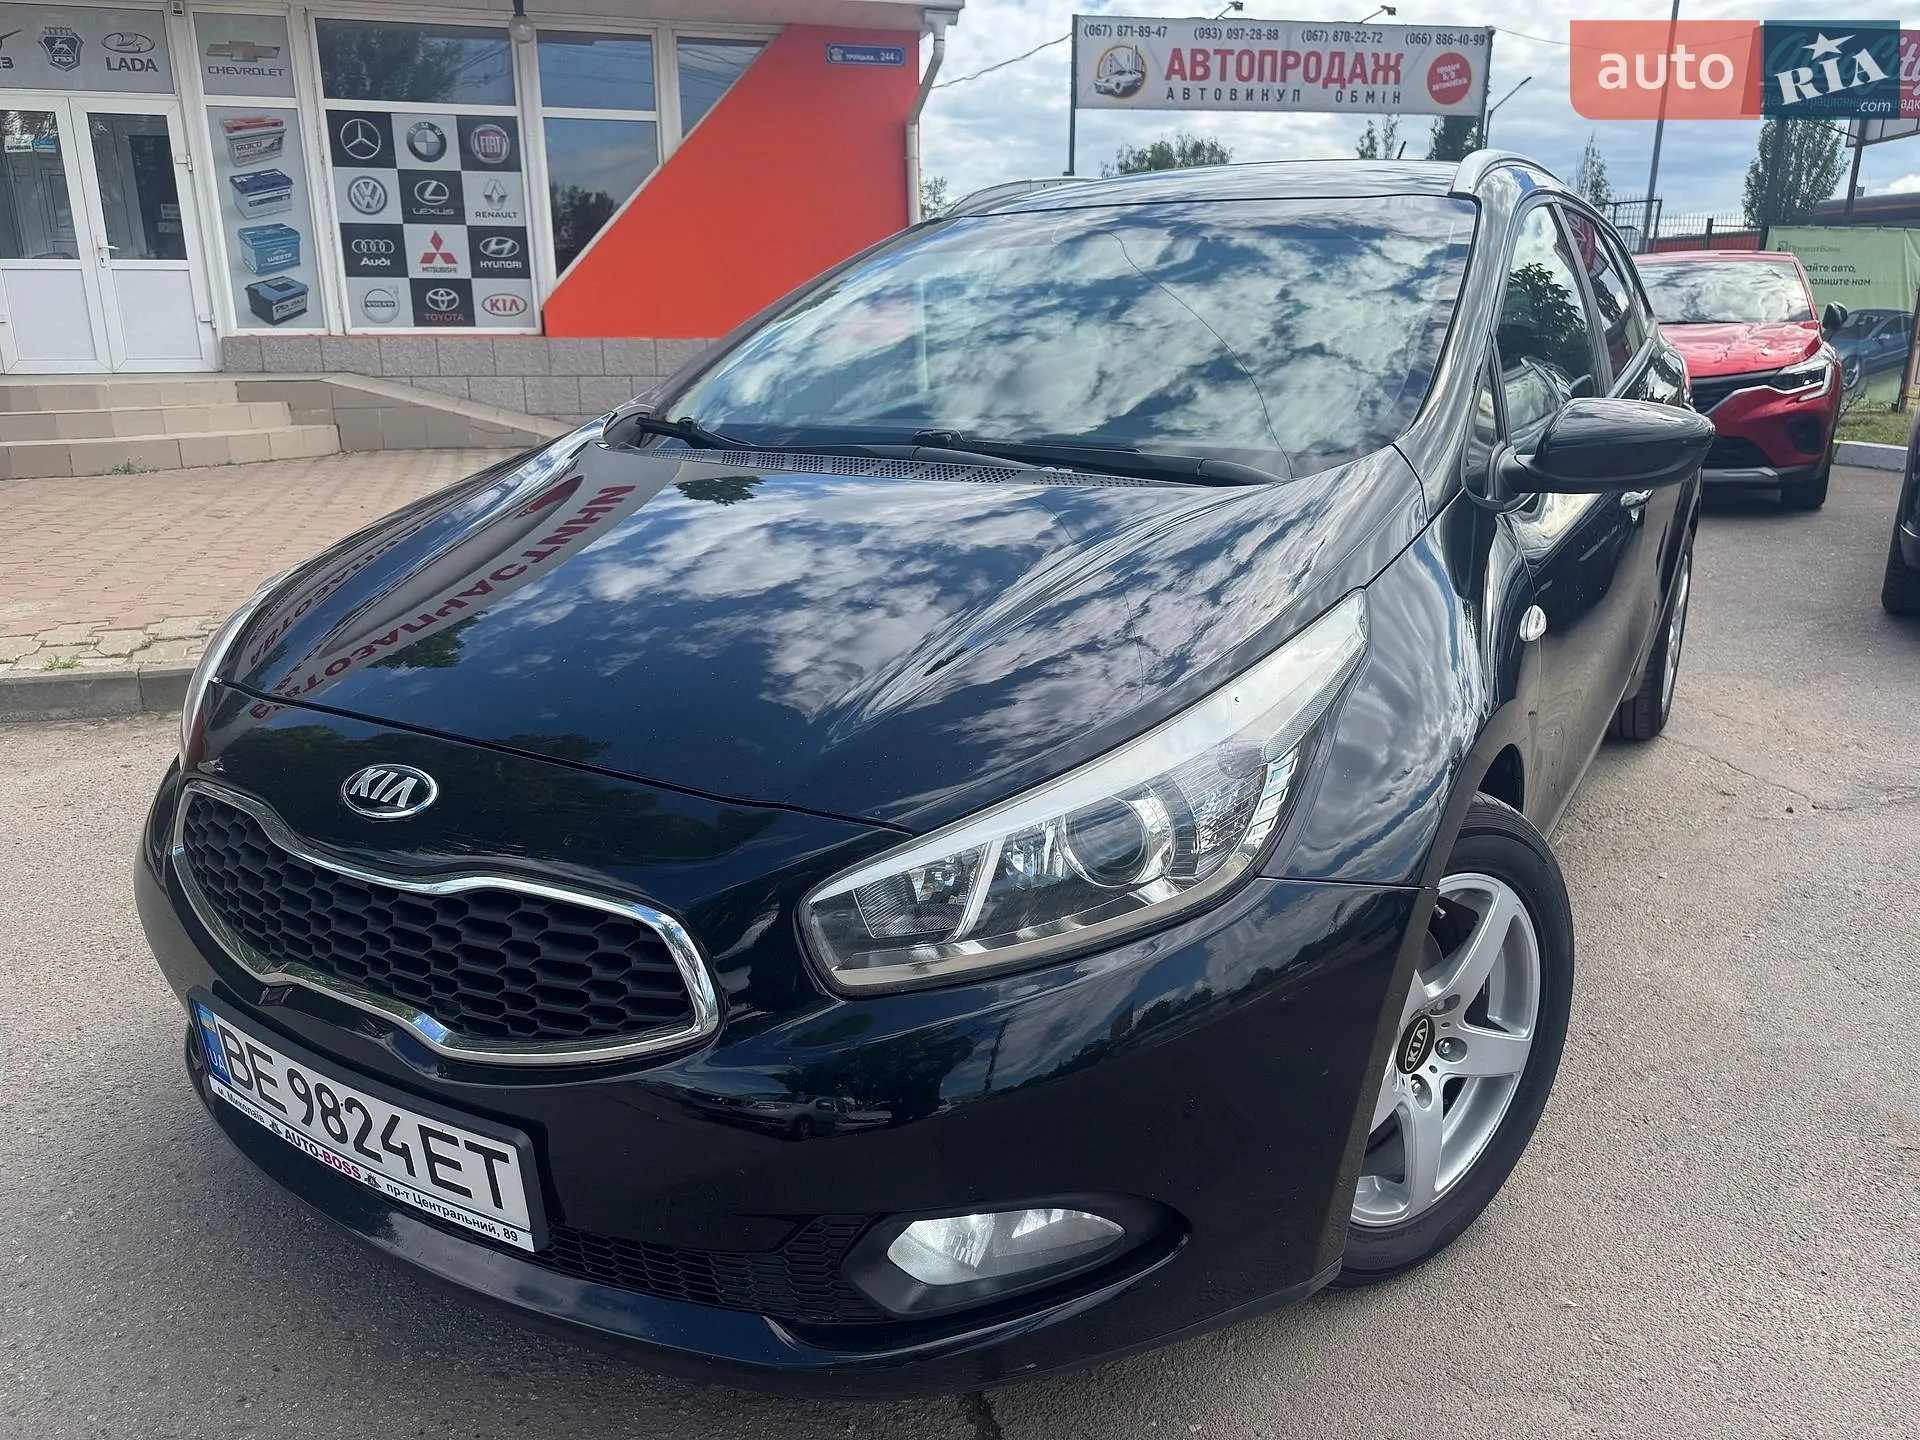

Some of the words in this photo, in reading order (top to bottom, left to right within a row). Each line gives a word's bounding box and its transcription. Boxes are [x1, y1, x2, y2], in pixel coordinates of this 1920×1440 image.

[1083, 24, 1112, 38] (067)
[1117, 24, 1168, 38] 871-89-47
[1194, 26, 1222, 40] (093)
[1227, 27, 1279, 40] 097-28-88
[1301, 30, 1328, 43] (067)
[1332, 30, 1383, 43] 870-22-72
[1405, 32, 1432, 46] (066)
[1435, 33, 1485, 46] 886-40-99
[106, 57, 159, 73] LADA
[208, 65, 285, 78] CHEVROLET
[1164, 48, 1403, 89] АВТОПРОДАЖ
[1166, 87, 1301, 102] АВТОВИКУП
[1335, 90, 1401, 104] ОБМІН
[479, 135, 506, 153] FIAT
[413, 207, 454, 215] LEXUS
[475, 211, 518, 219] RENAULT
[360, 257, 391, 266] Audi
[479, 261, 522, 269] HYUNDAI
[1803, 263, 1829, 272] айте
[1831, 264, 1856, 273] авто,
[489, 299, 520, 312] KIA
[424, 313, 465, 321] TOYOTA
[349, 768, 418, 808] KIA
[1408, 1028, 1426, 1062] KIA
[209, 1048, 227, 1072] UA
[284, 1129, 361, 1180] AUTO-BOSS
[386, 1183, 411, 1200] пр-т
[412, 1192, 500, 1238] Центральний,
[503, 1227, 518, 1242] 89
